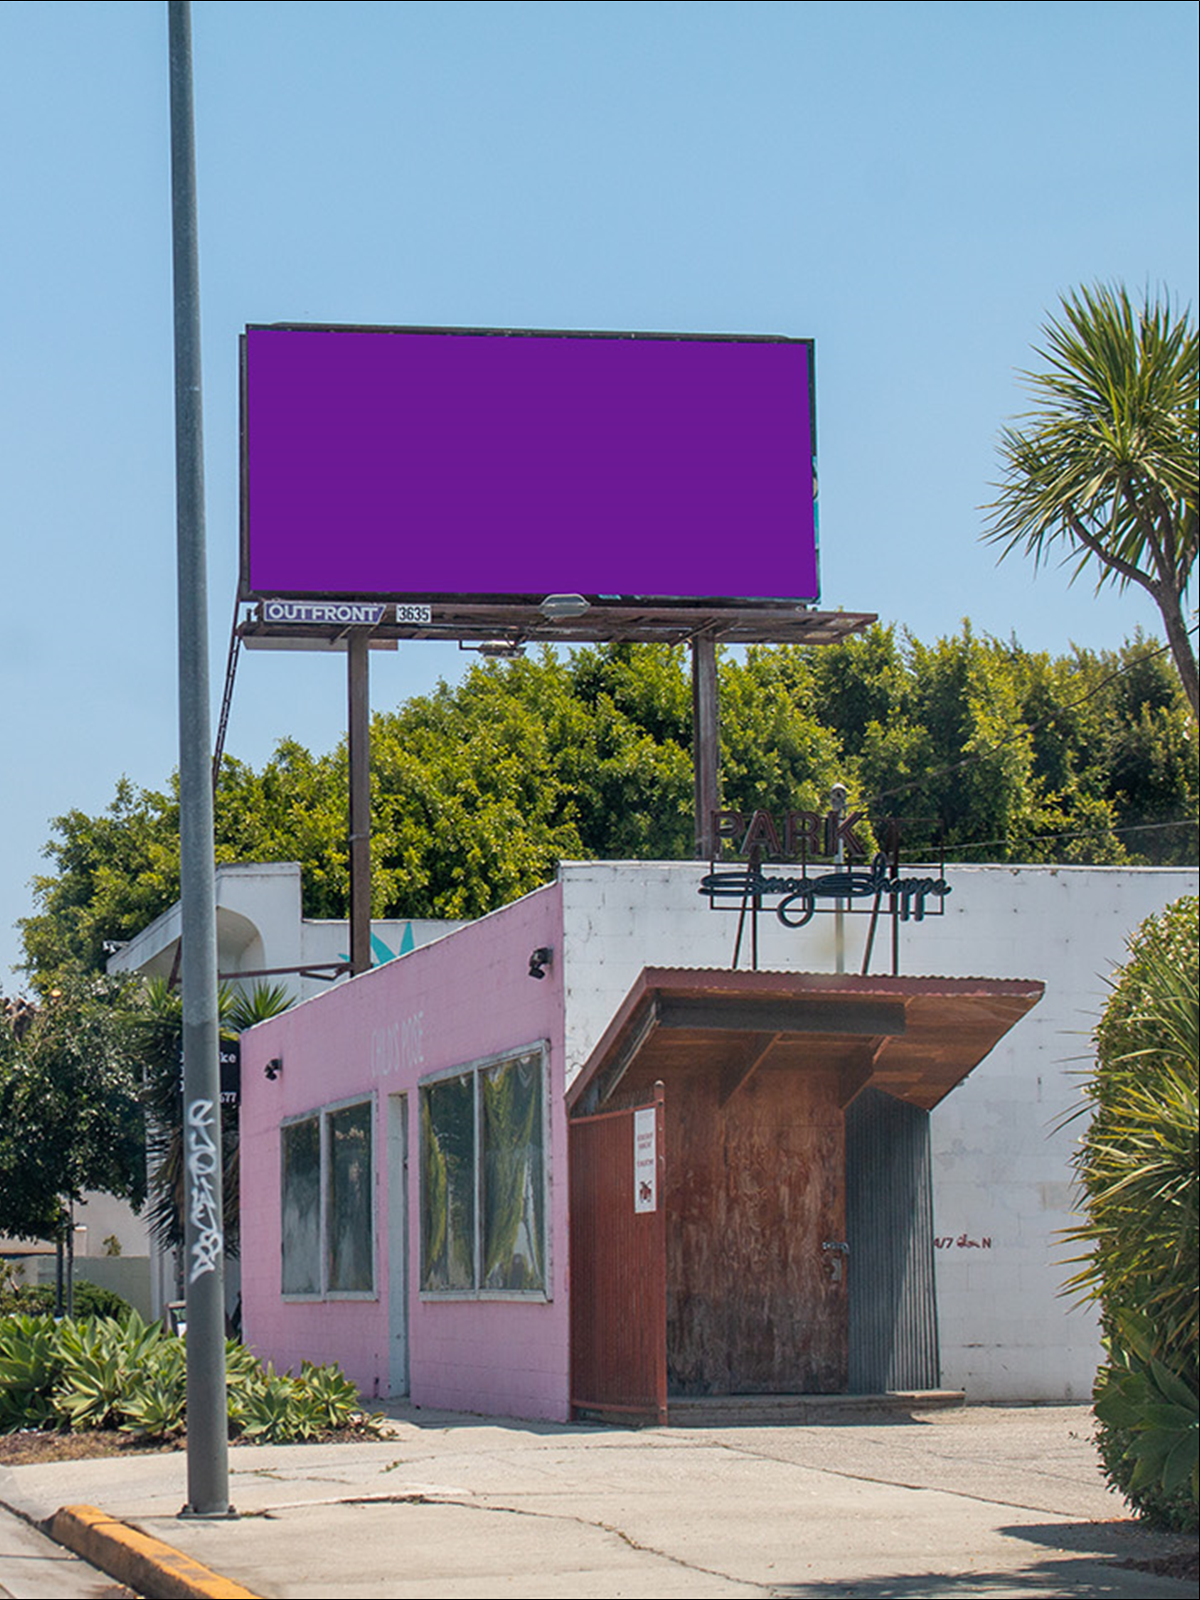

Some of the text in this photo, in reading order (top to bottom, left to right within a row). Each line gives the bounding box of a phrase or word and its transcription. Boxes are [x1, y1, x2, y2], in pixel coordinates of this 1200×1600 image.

[268, 604, 379, 622] OUTFRONT
[399, 605, 430, 622] 3635
[710, 809, 868, 855] PARK
